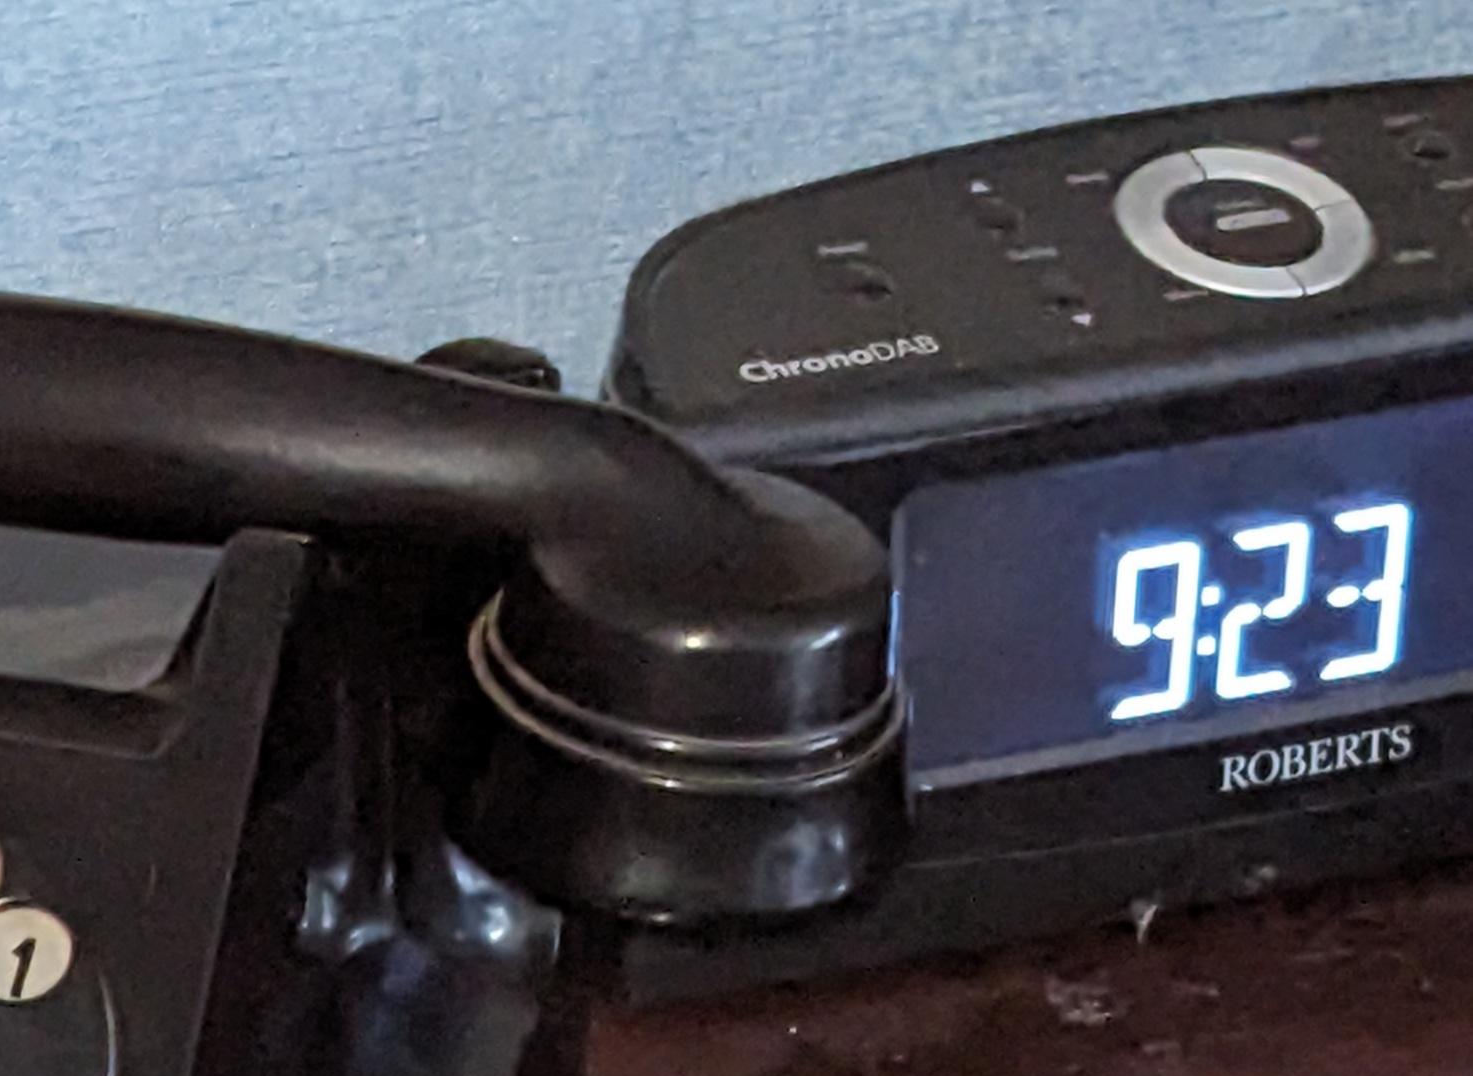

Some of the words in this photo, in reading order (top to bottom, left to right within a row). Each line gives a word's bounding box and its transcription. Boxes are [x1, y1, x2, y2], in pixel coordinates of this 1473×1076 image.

[739, 334, 939, 384] ChronoDAB
[1109, 503, 1411, 720] 9:23
[1219, 724, 1412, 792] ROBERTS
[10, 937, 36, 998] 1
